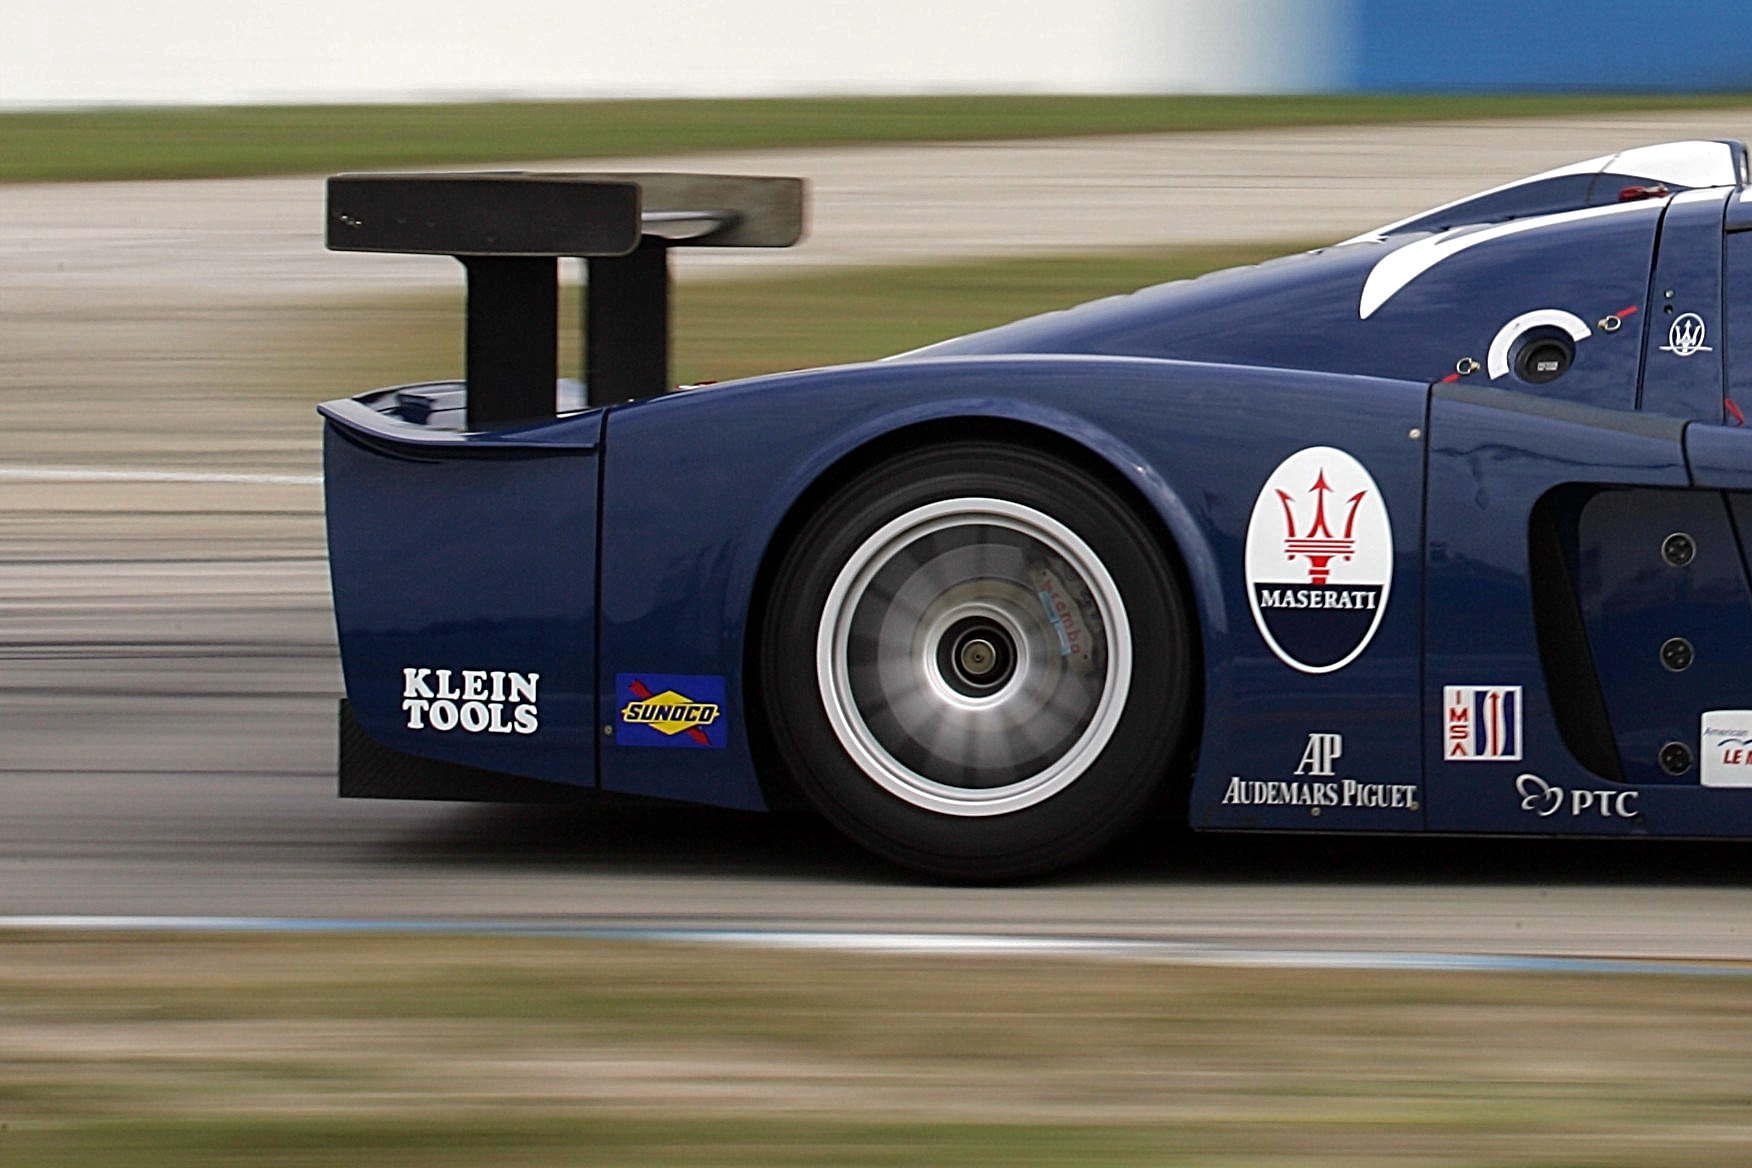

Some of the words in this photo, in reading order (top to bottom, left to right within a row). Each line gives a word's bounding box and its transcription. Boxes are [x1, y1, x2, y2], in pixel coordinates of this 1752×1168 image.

[1260, 589, 1377, 610] MASERATI
[403, 668, 539, 702] KLEIN
[402, 699, 539, 734] TOOLS
[626, 705, 716, 722] SUNOCO
[1449, 689, 1469, 756] IMSA
[1294, 733, 1342, 776] AP
[1723, 748, 1742, 764] LE
[1222, 776, 1338, 807] AUDEMARS
[1342, 781, 1417, 808] PIGUET
[1572, 789, 1639, 818] PTC
